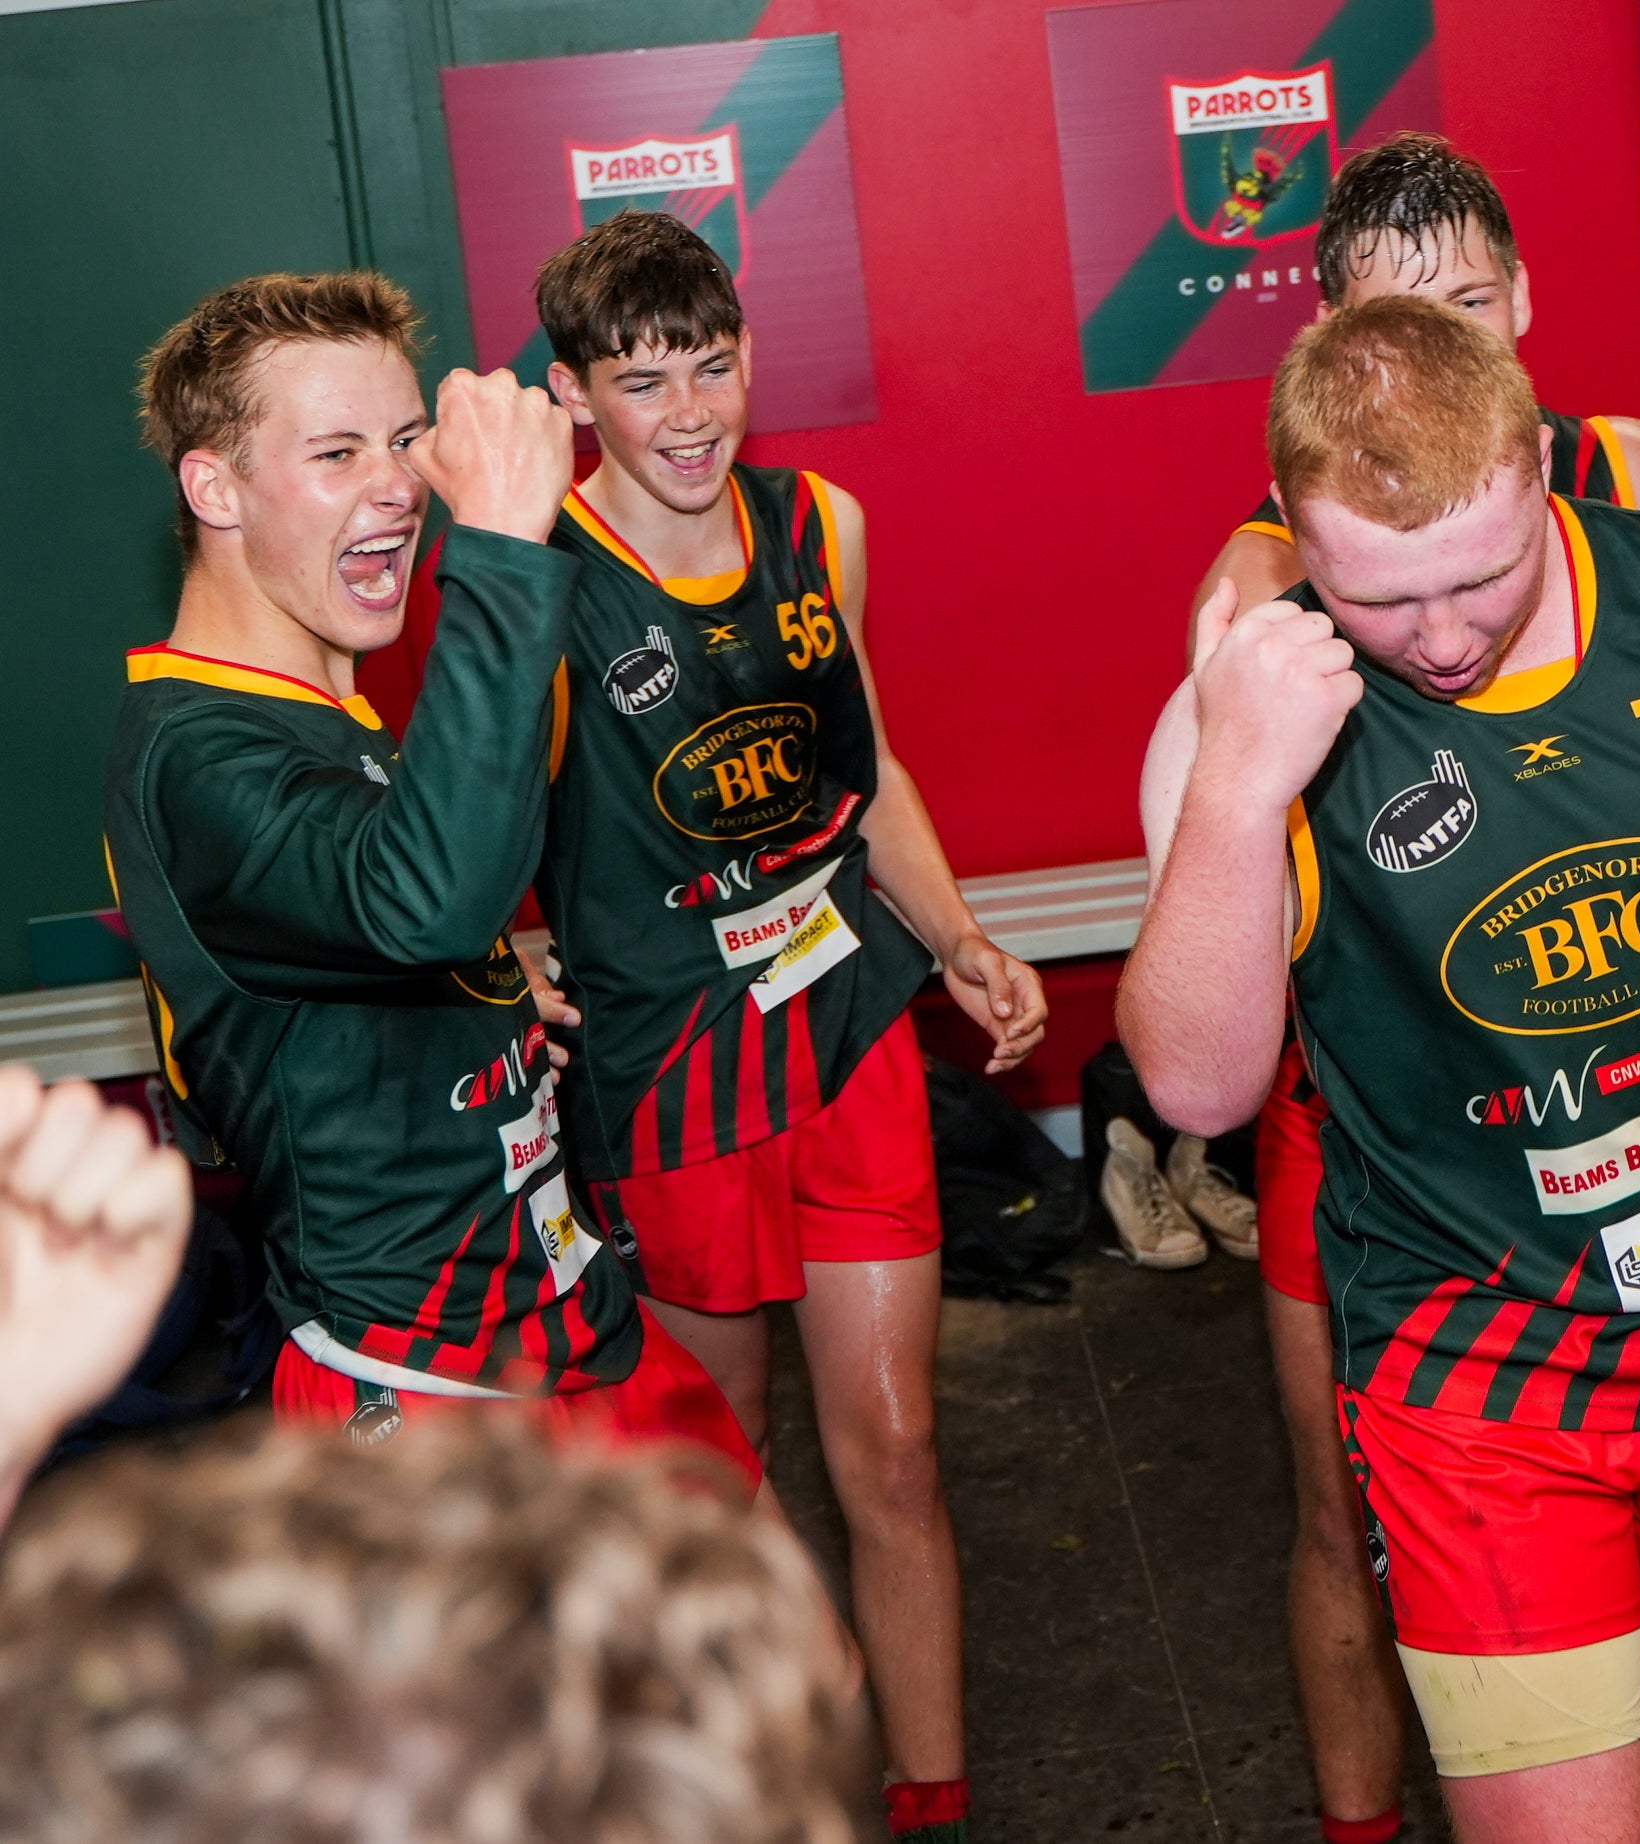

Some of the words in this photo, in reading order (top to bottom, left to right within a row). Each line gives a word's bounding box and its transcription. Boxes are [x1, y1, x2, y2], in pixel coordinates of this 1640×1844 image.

[1186, 85, 1312, 118] PARROTS
[588, 149, 718, 183] PARROTS
[776, 592, 837, 670] 56
[629, 662, 675, 706] NTFA
[680, 714, 805, 771] BRIDGENORTH
[708, 733, 803, 812] BFC
[1513, 755, 1581, 782] XBLADES
[1407, 797, 1472, 860] NTFA
[724, 918, 786, 952] BEAMS
[782, 911, 830, 956] IMPACT
[1493, 957, 1527, 975] EST.
[1522, 983, 1638, 1015] FOOTBALL
[1540, 1159, 1619, 1195] BEAMS
